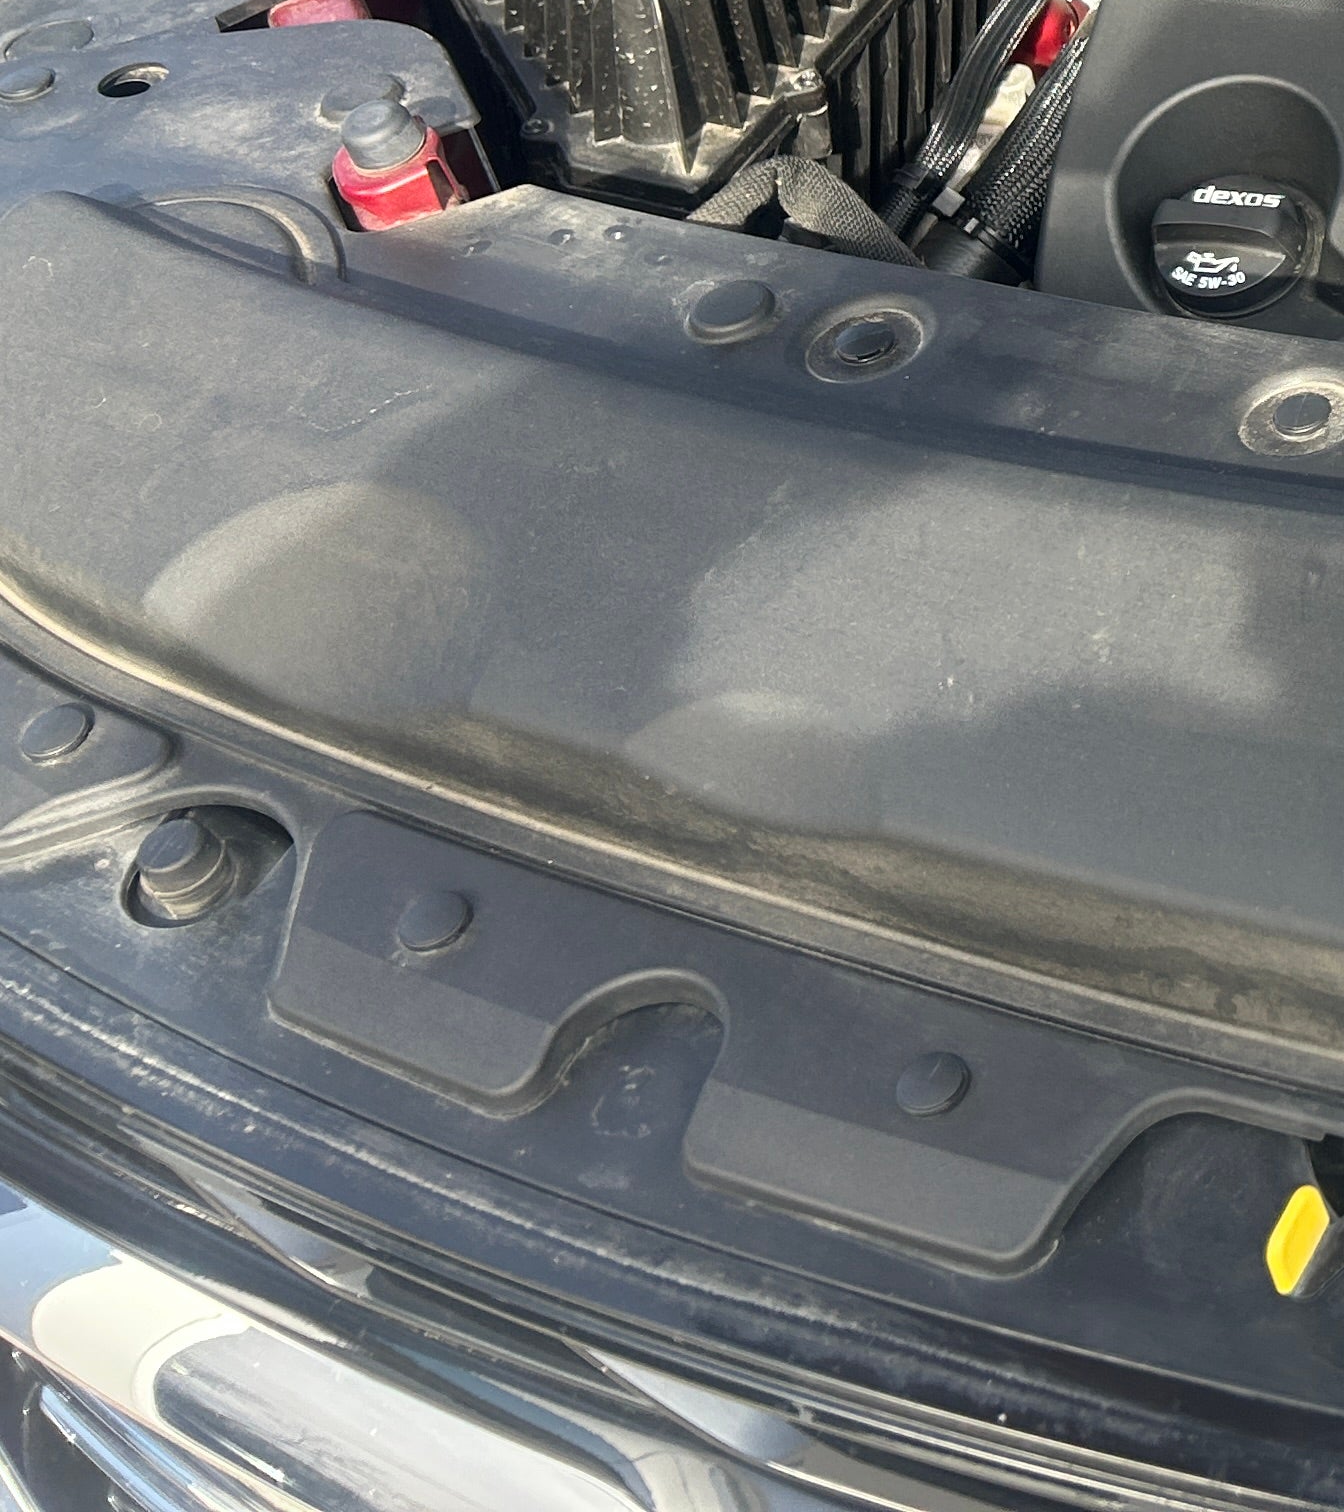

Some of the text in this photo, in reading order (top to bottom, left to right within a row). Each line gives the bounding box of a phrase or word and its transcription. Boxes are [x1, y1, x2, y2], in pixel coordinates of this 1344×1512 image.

[1193, 185, 1285, 208] dexos
[1171, 266, 1246, 289] SAE 5W-30
